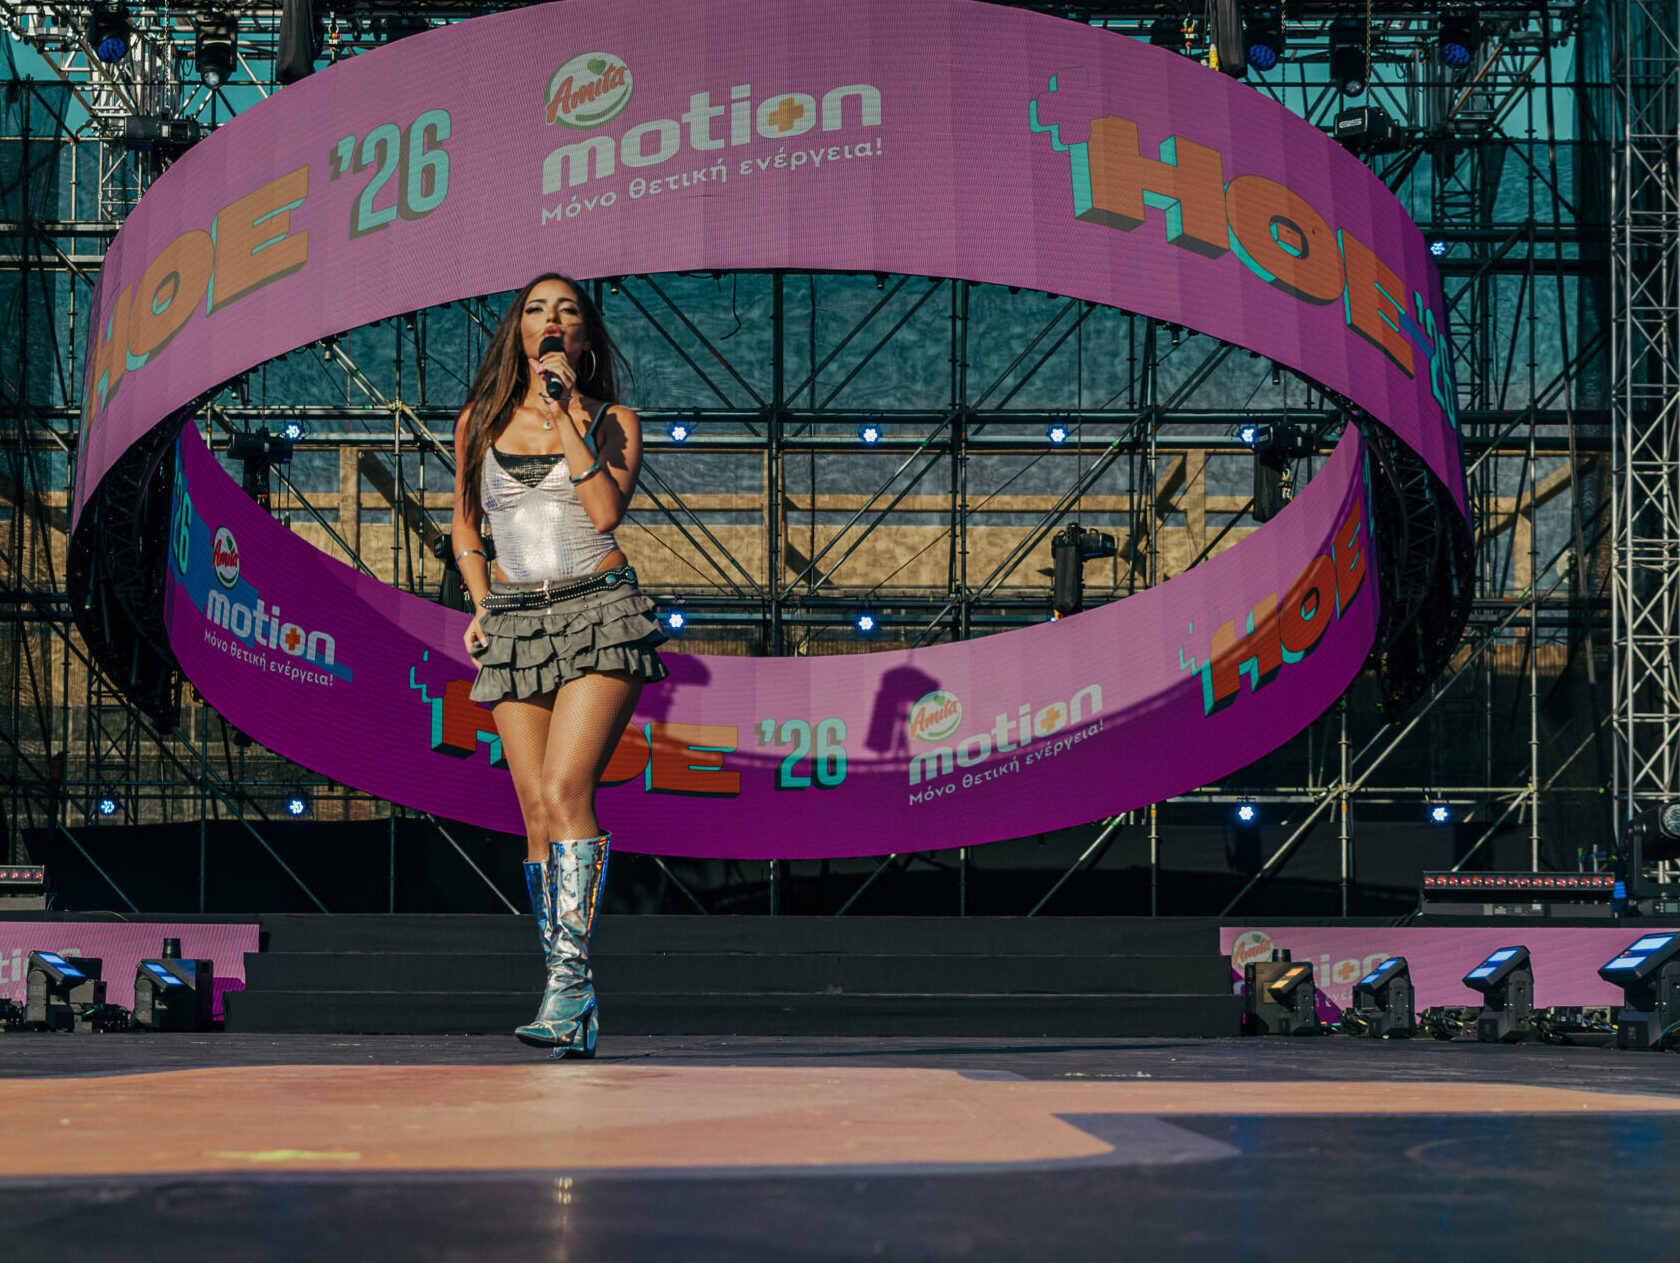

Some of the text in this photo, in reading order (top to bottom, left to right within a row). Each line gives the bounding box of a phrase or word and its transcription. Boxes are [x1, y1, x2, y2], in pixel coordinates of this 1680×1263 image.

[546, 62, 628, 125] Amita
[541, 137, 883, 226] Μόνο θετική ενέργεια!
[542, 84, 882, 195] motion
[1072, 114, 1415, 380] HOE
[212, 539, 239, 568] Amita
[207, 588, 336, 665] motion
[1201, 495, 1367, 718] HOE
[204, 629, 334, 687] Μόνο θετική ενέργεια!
[909, 684, 1103, 785] motion
[909, 718, 1104, 806] Μόνο θετική ενέργεια!
[910, 699, 959, 737] Amita
